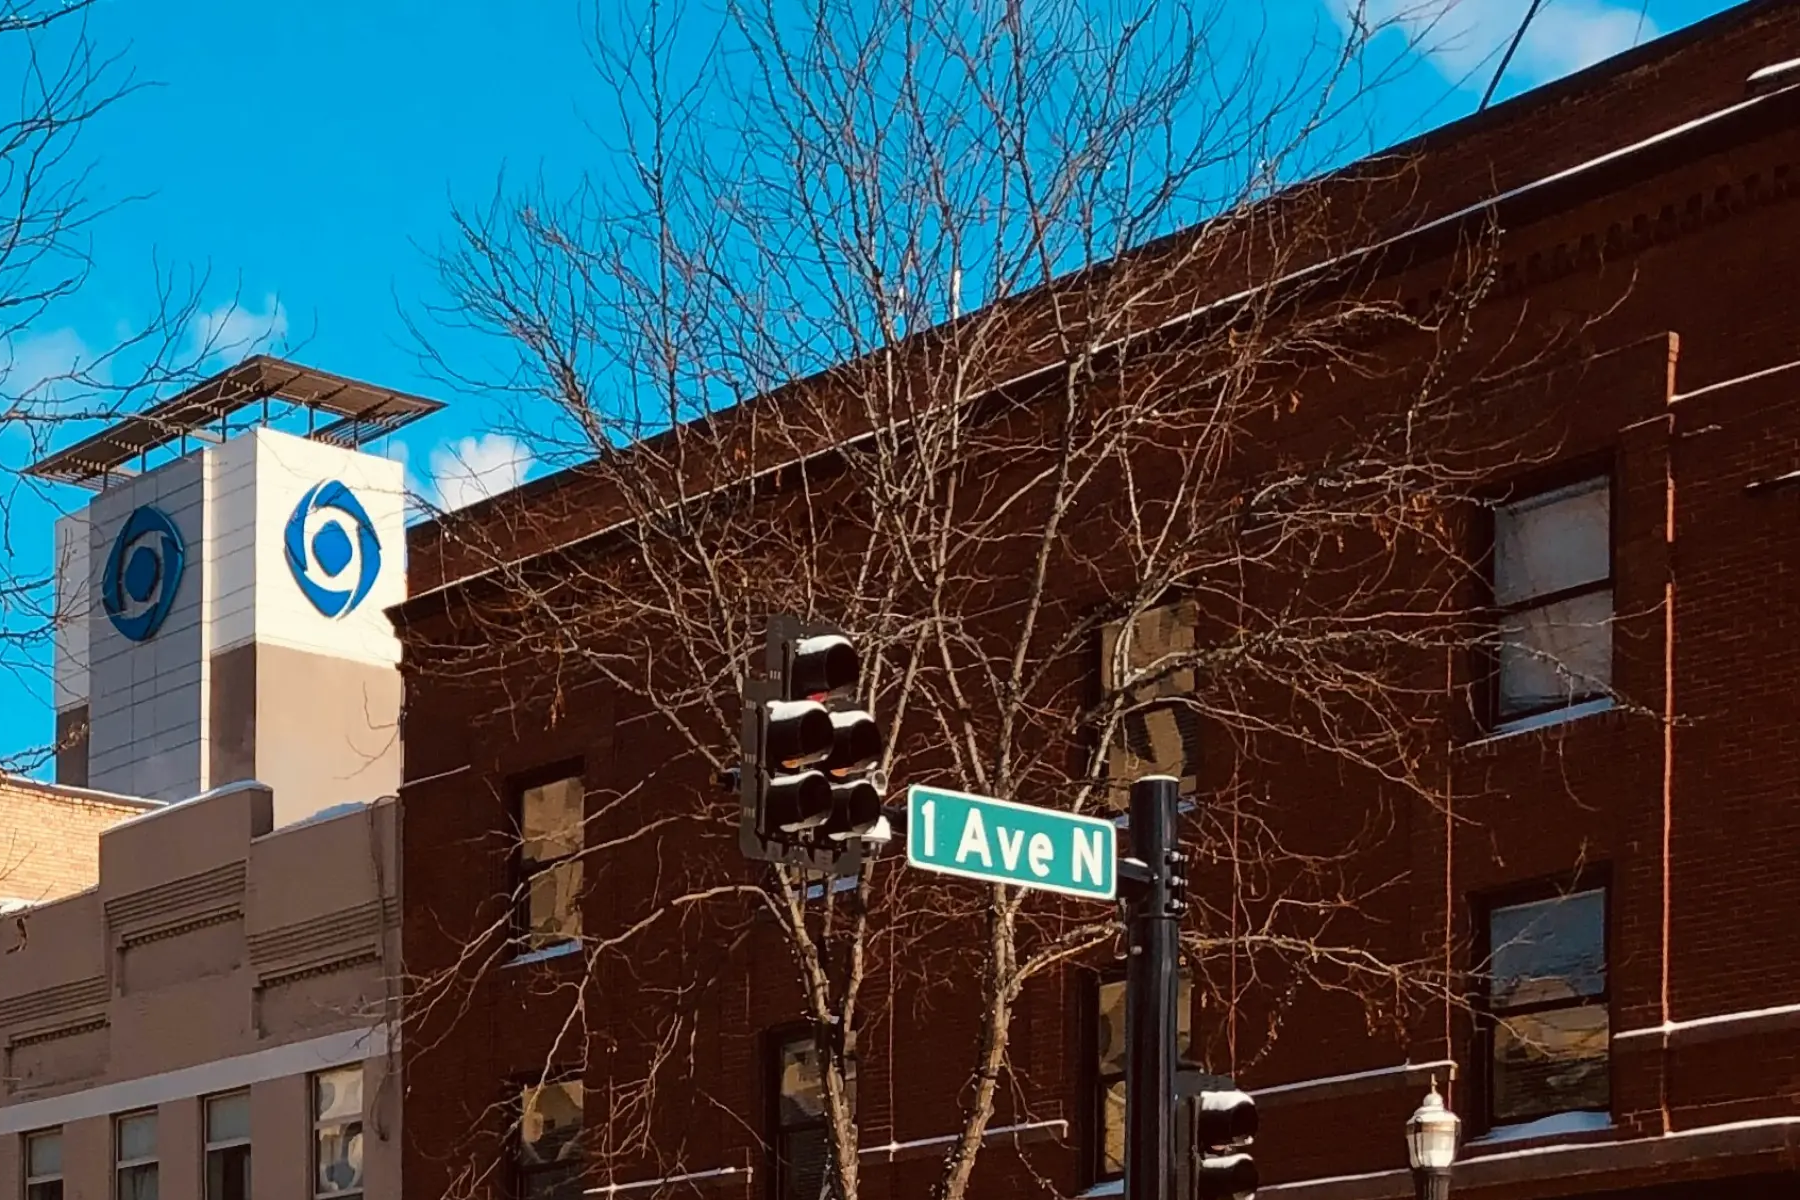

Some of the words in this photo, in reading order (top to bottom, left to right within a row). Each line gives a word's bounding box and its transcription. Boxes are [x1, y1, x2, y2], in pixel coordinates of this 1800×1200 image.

[921, 800, 935, 857] 1
[955, 808, 1054, 878] Ave
[1072, 827, 1104, 886] N
